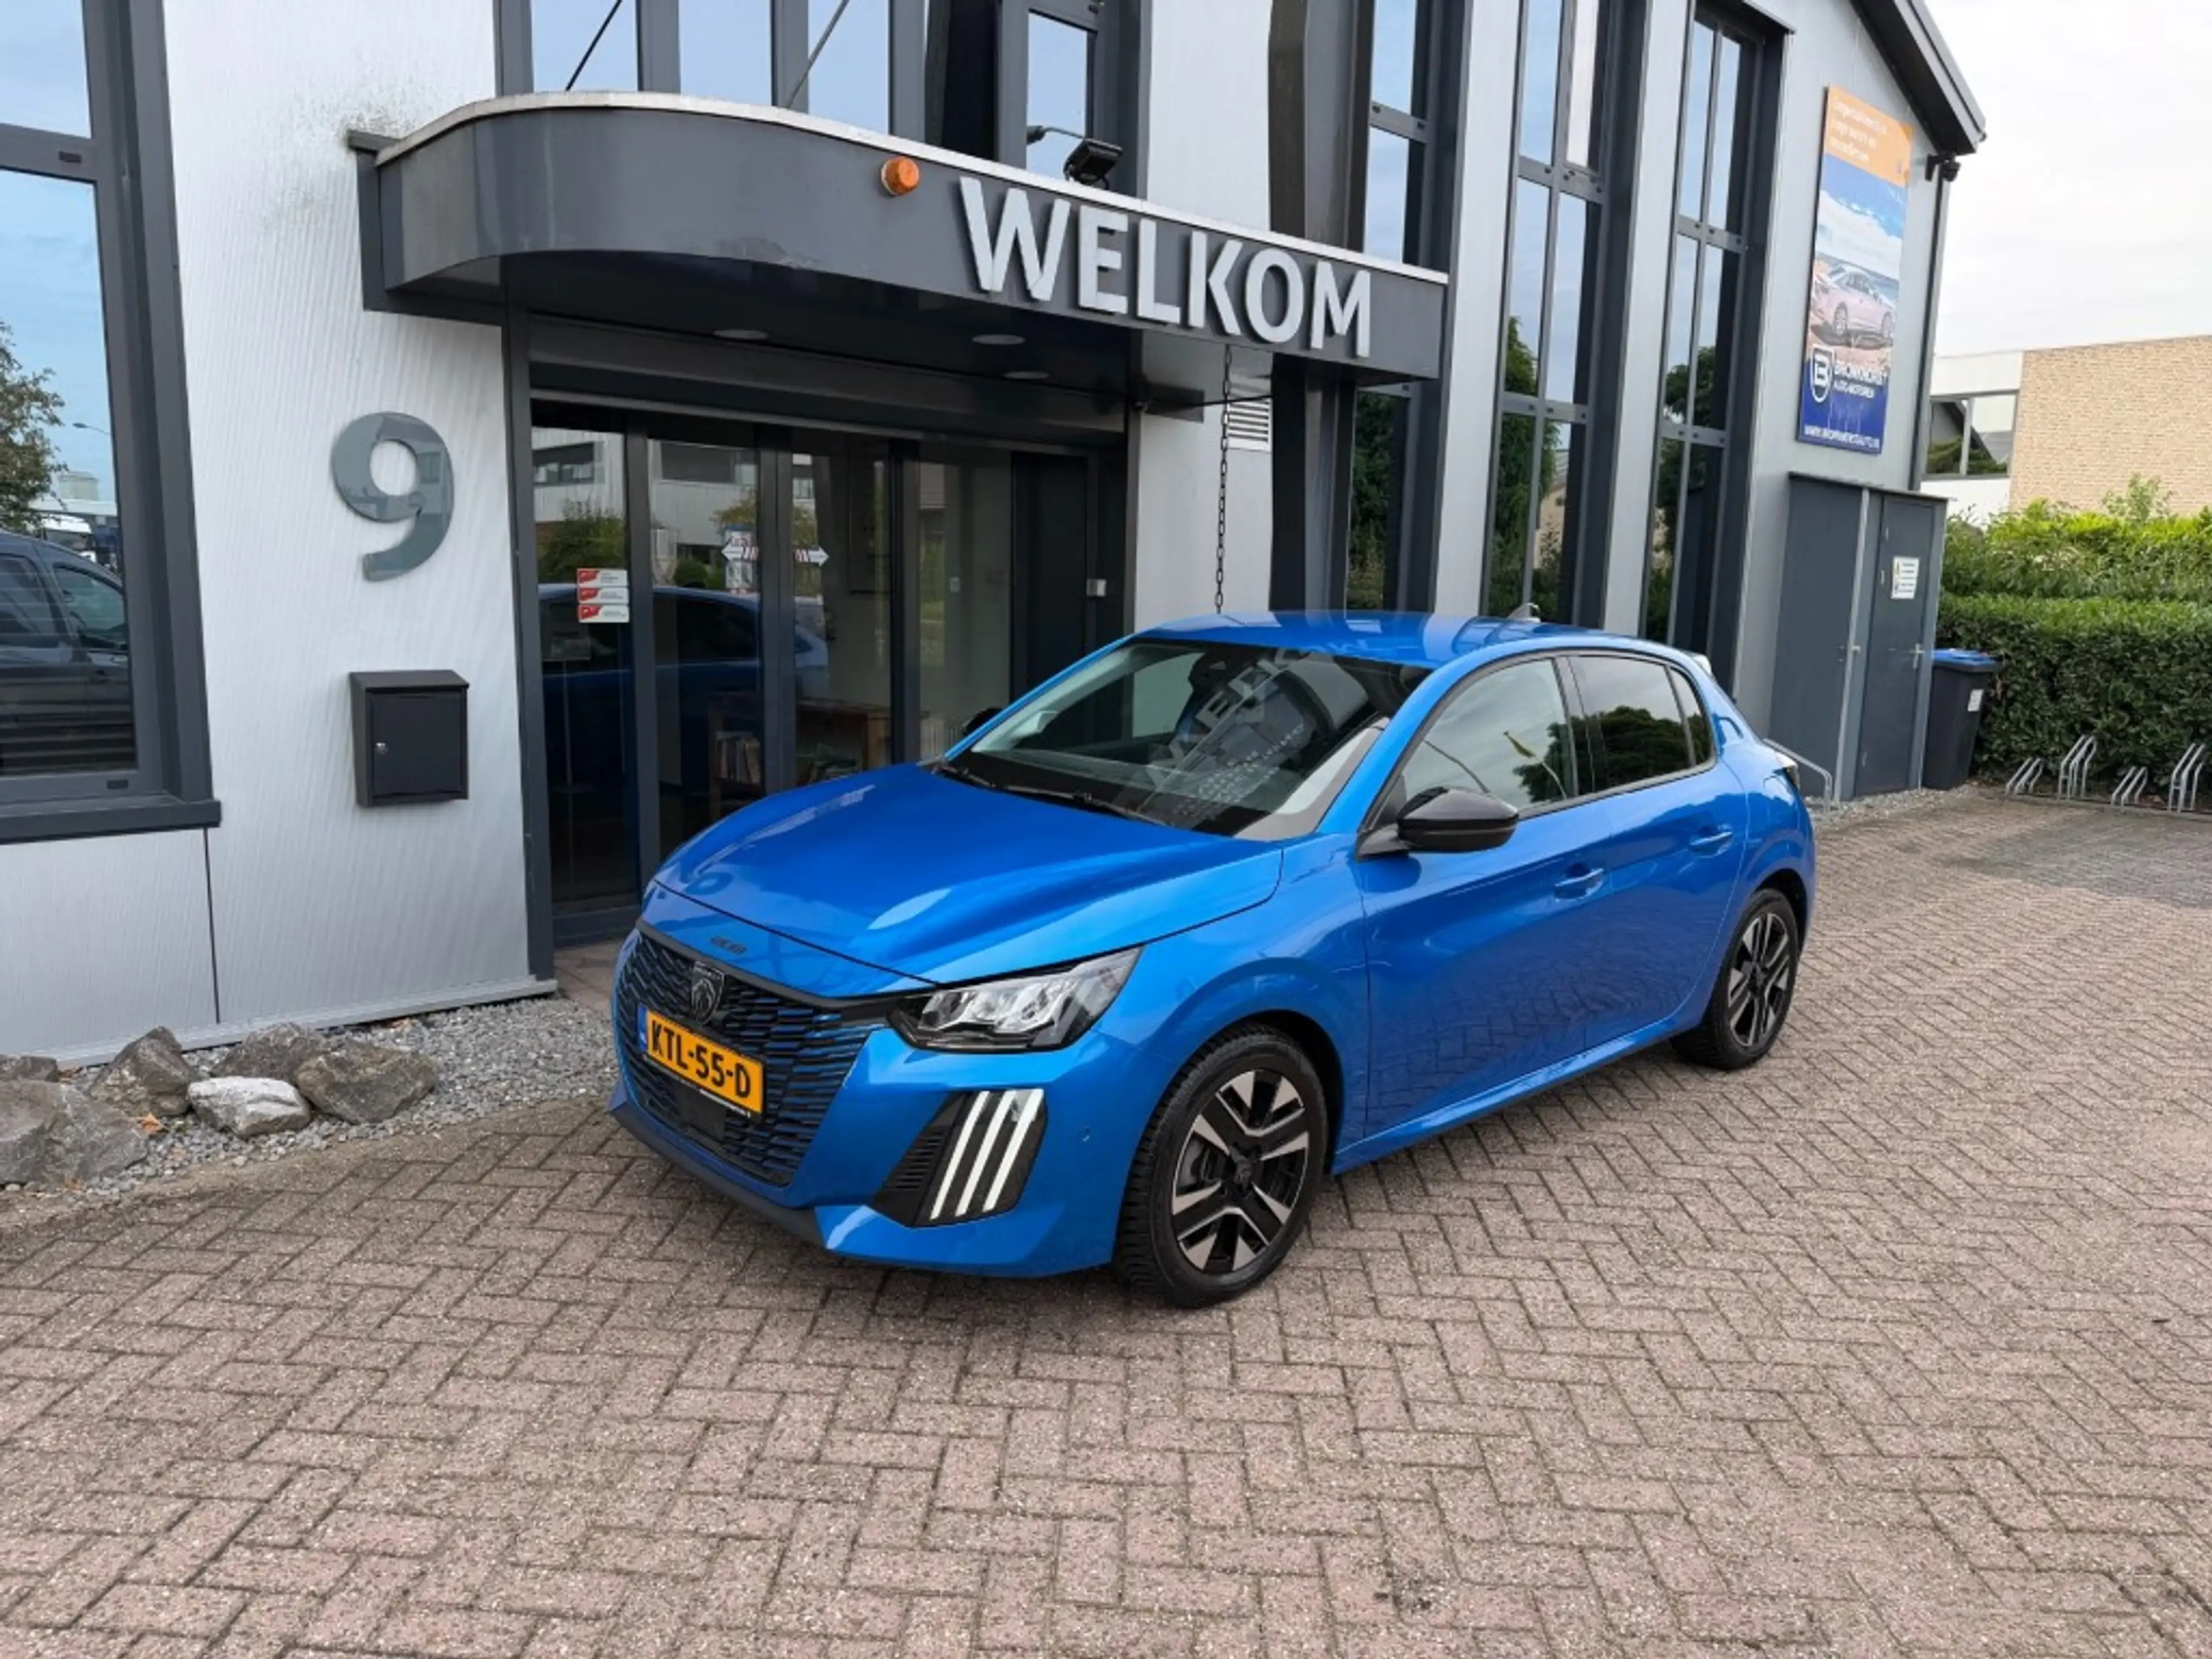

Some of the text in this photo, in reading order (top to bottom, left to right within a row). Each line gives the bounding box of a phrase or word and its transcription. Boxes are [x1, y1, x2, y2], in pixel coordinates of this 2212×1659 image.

[959, 176, 1370, 358] WELKOM
[332, 411, 454, 582] 9
[652, 1020, 751, 1098] KTL-55-D
